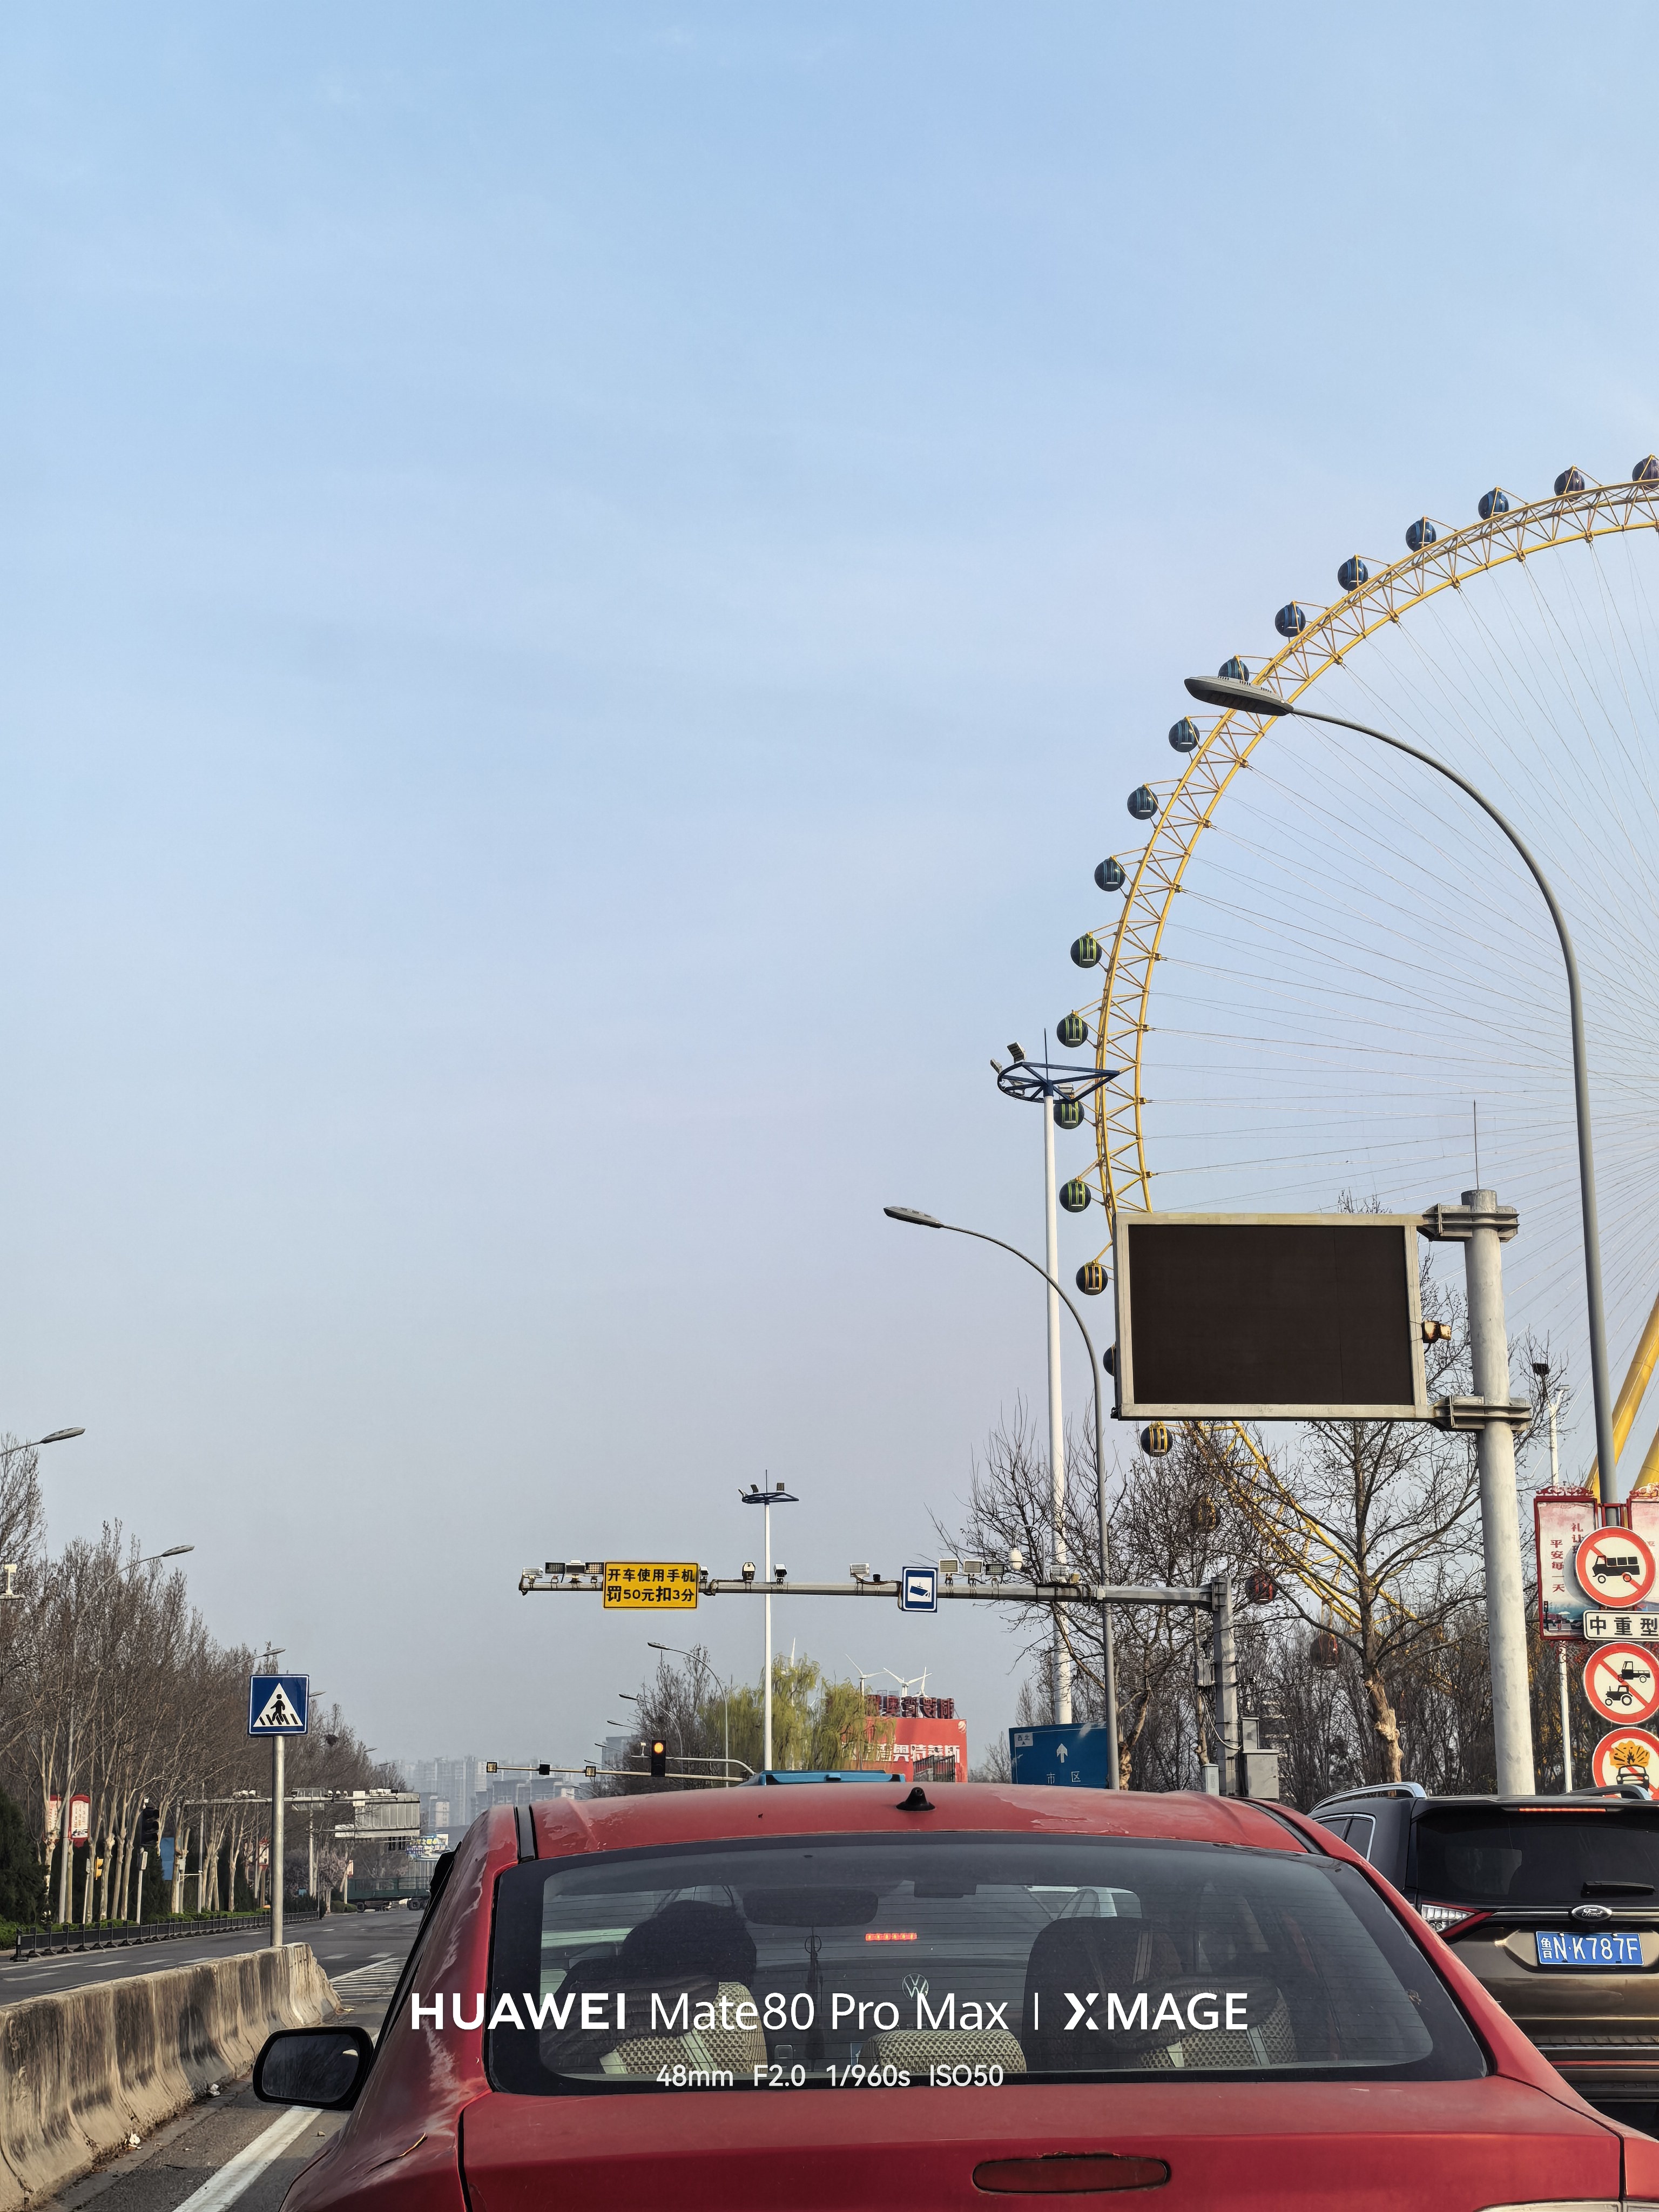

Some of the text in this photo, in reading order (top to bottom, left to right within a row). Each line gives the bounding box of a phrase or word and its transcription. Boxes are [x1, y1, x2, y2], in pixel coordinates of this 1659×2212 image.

[607, 1568, 696, 1582] 开车使用手机
[1550, 1540, 1565, 1593] 平安每一天
[606, 1585, 695, 1602] 罚50元扣3分
[1589, 1615, 1658, 1636] 中重型
[1047, 1771, 1081, 1784] 市区
